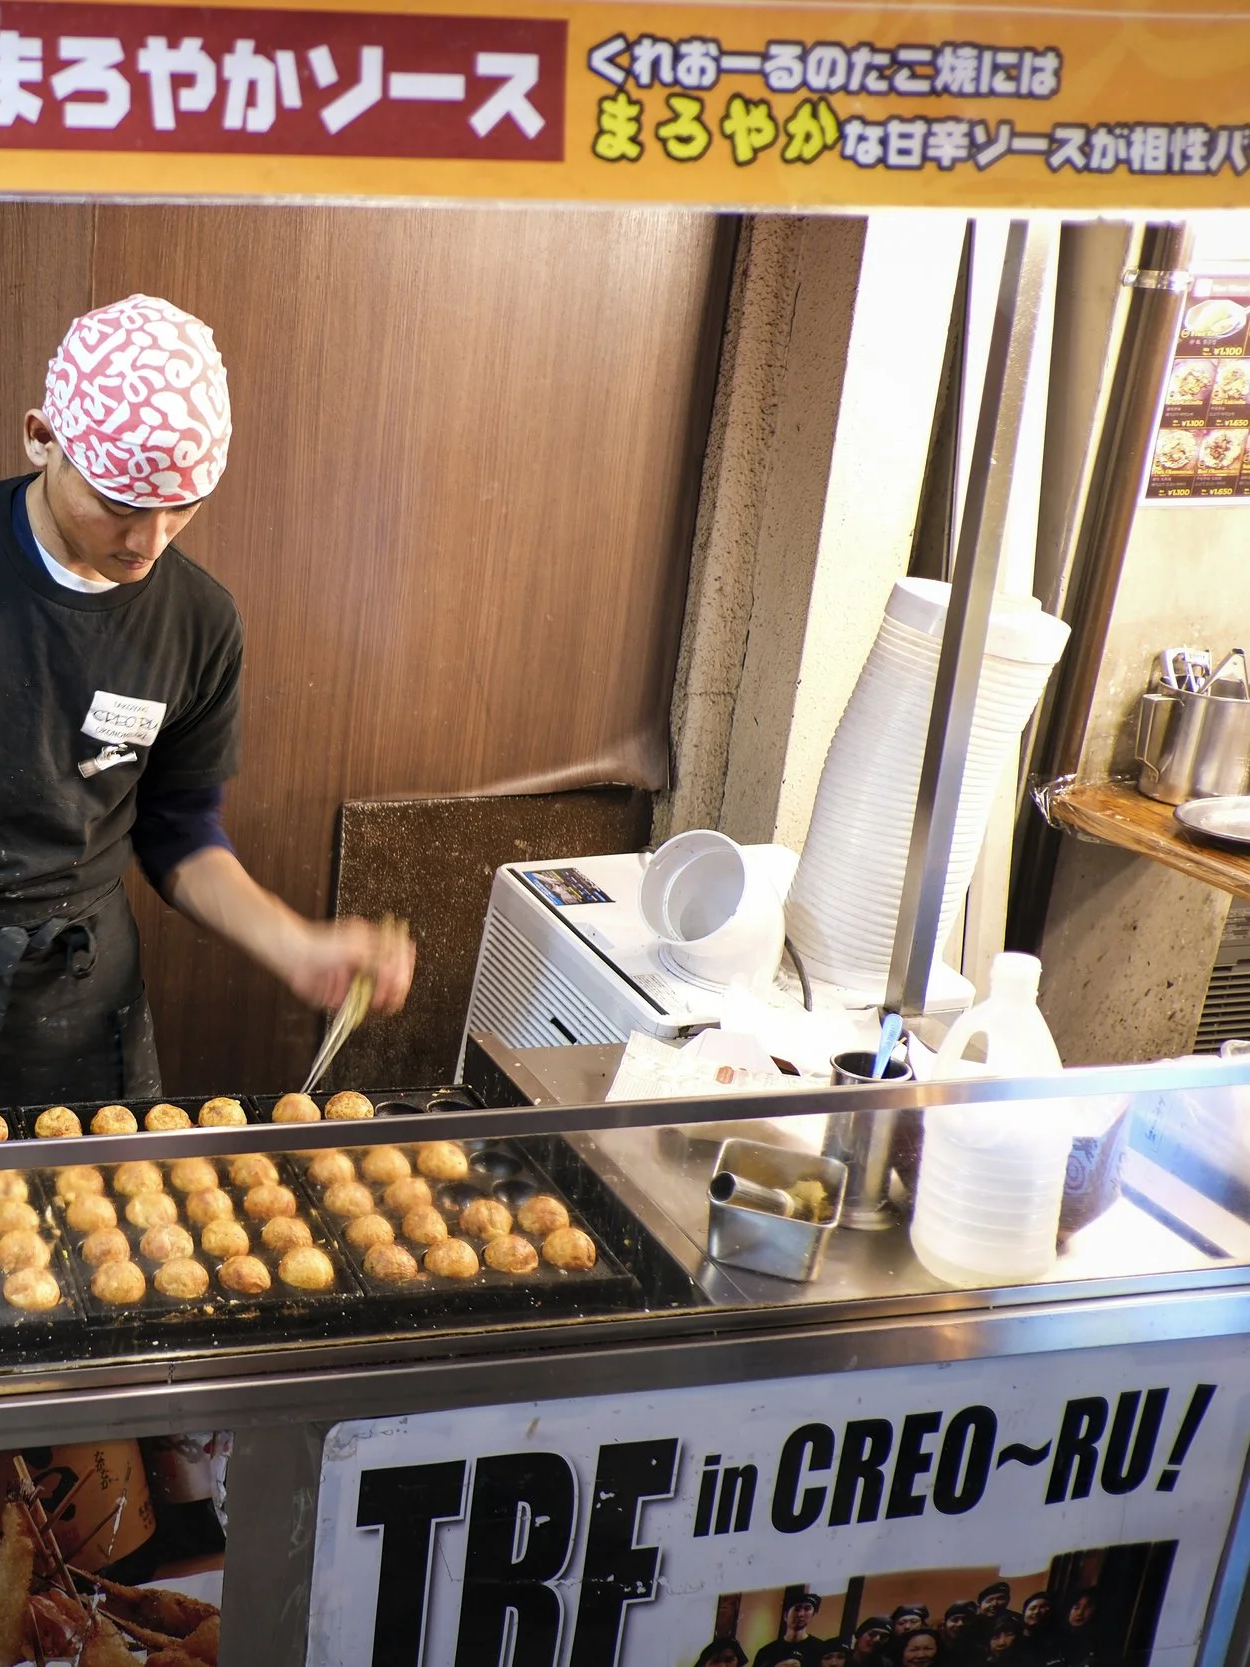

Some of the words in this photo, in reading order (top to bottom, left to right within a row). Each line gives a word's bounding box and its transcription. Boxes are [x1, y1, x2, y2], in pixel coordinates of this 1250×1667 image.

[587, 34, 1062, 98] くれおーるのたこ焼には
[693, 1454, 759, 1538] in
